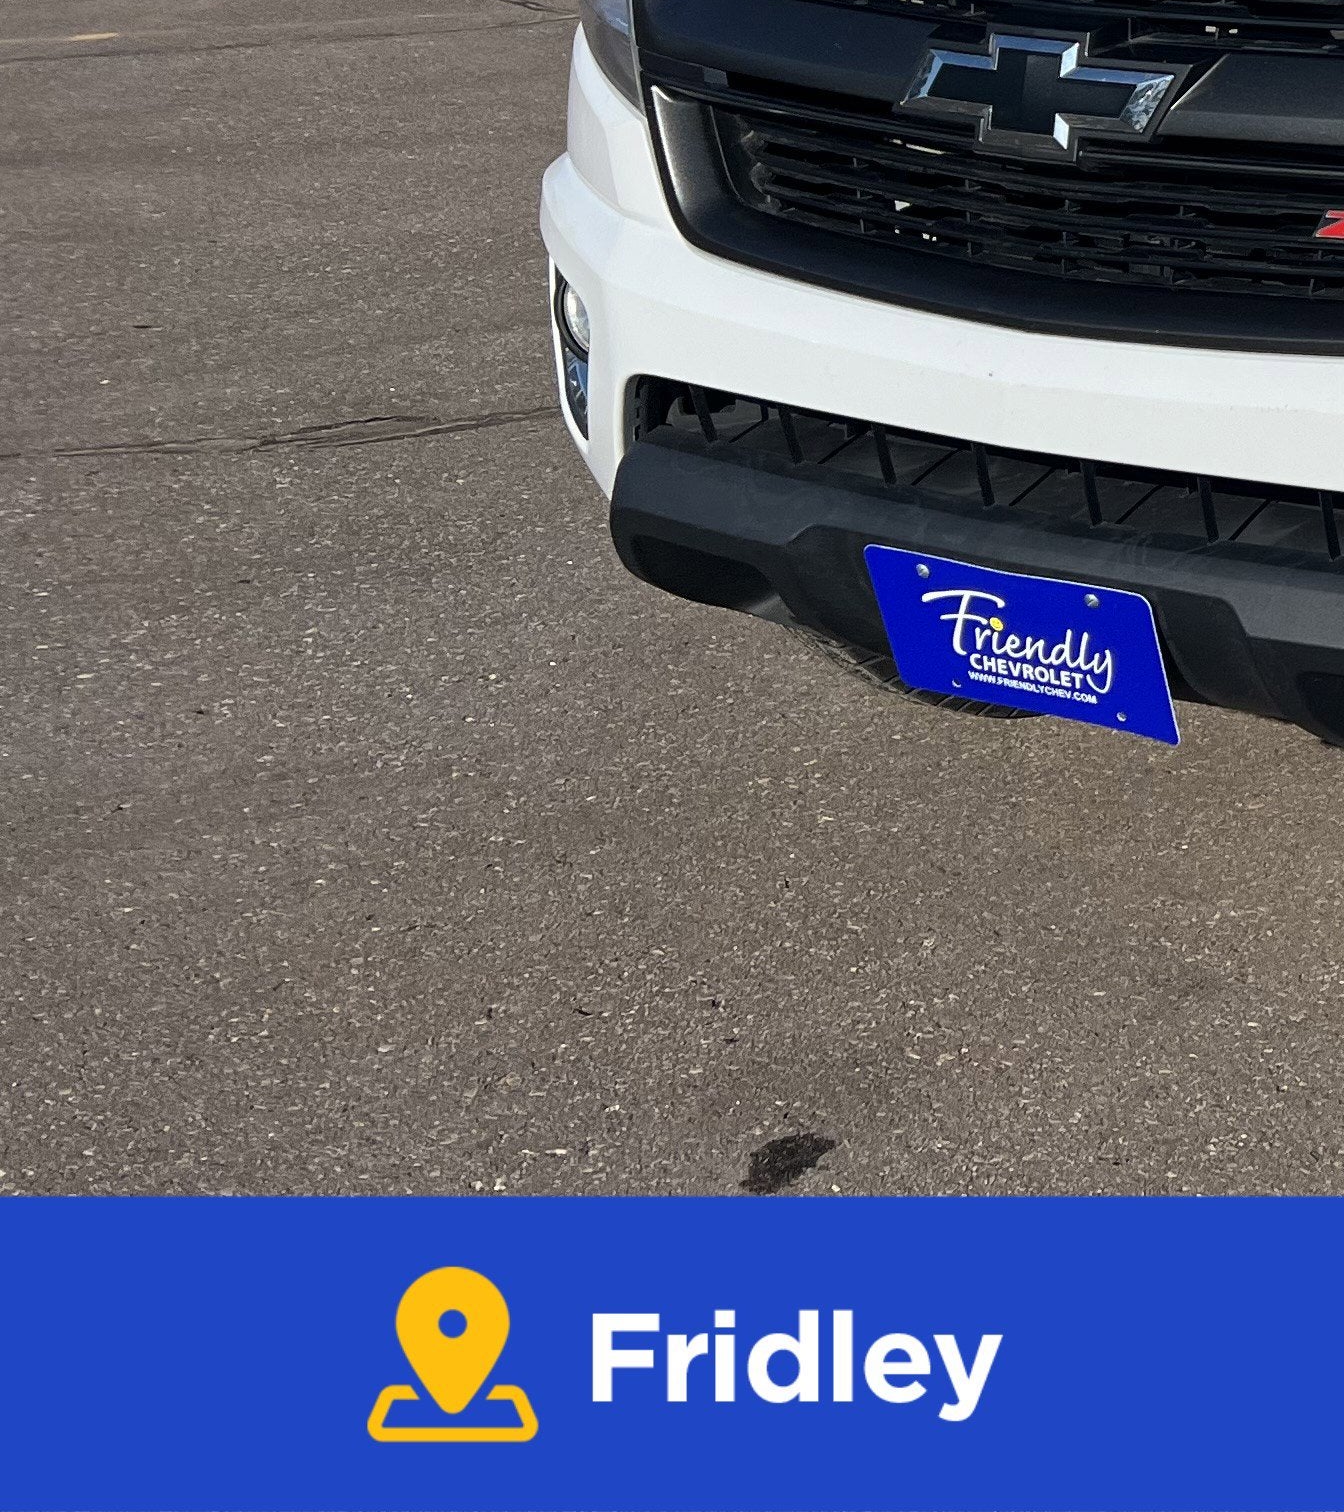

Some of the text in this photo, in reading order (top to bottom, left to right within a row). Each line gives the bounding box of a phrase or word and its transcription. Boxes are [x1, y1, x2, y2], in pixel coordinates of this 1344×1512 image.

[921, 589, 1113, 694] Friendly
[968, 670, 1098, 705] WWW.FRIENDLYCHEV.COM
[969, 653, 1084, 689] CHEVROLET
